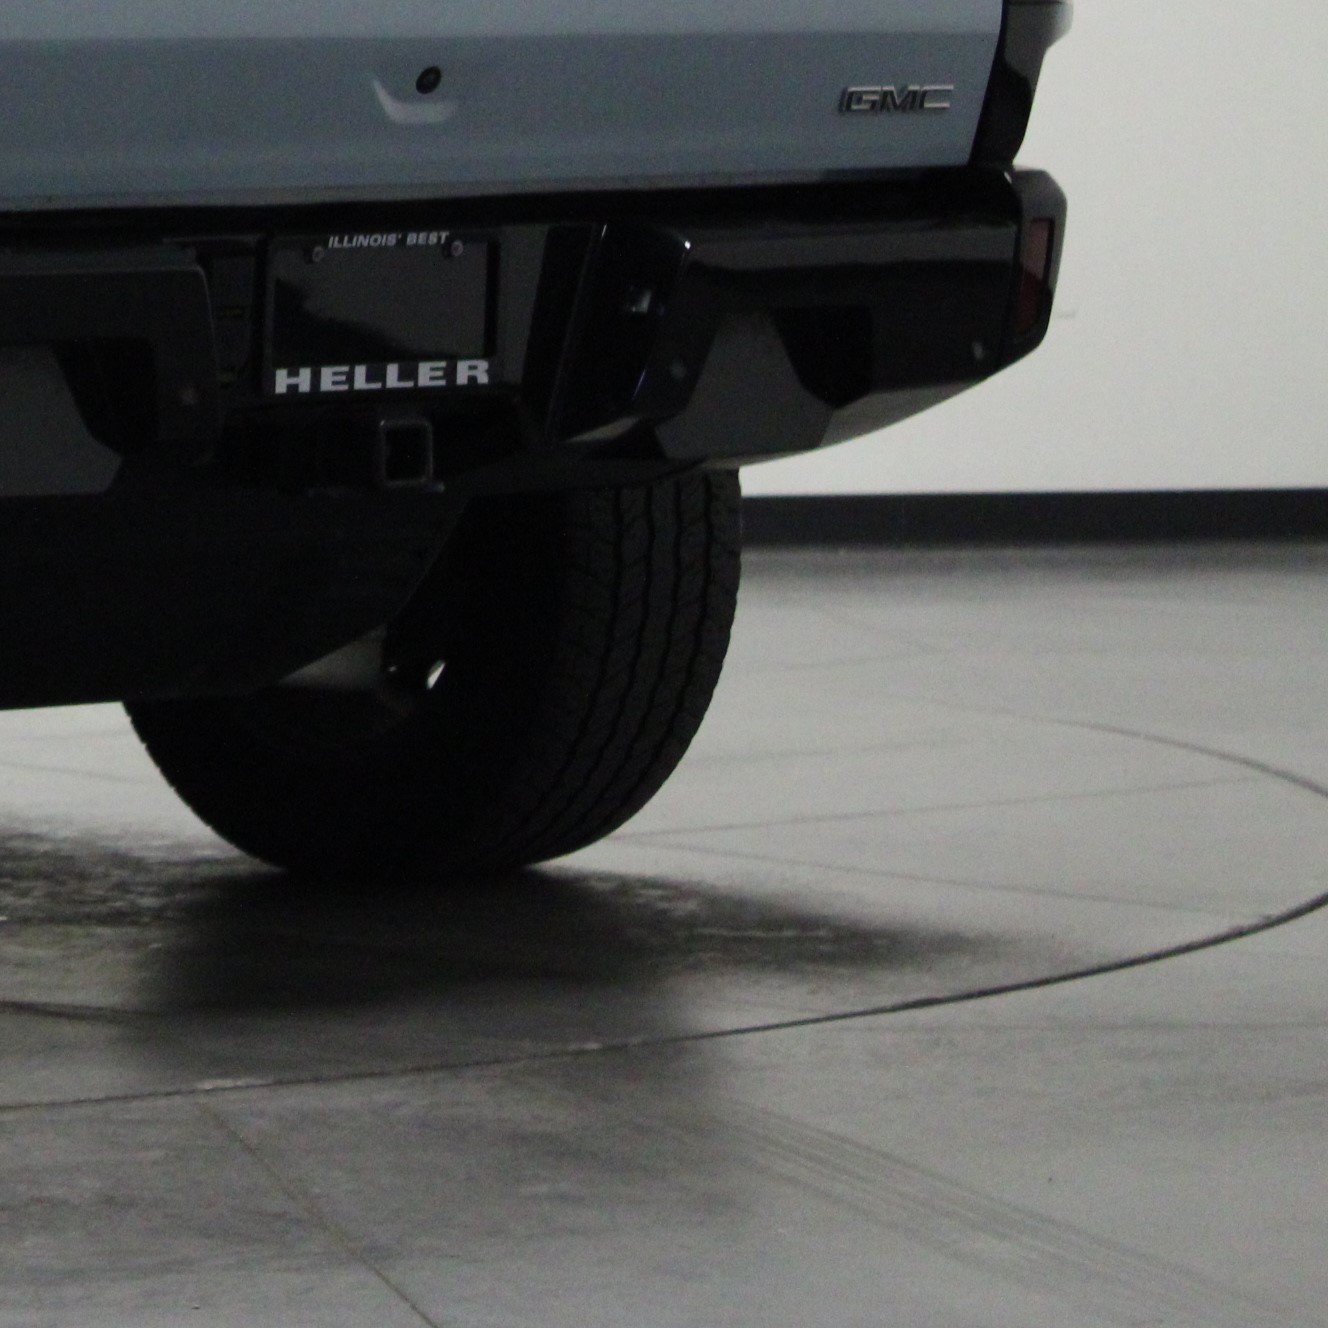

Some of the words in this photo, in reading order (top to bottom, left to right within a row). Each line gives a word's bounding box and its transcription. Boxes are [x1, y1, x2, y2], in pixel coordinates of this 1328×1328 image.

[839, 83, 954, 114] GMC
[328, 233, 402, 249] ILLINOIS'
[406, 230, 450, 246] BEST
[274, 359, 490, 395] HELLER
